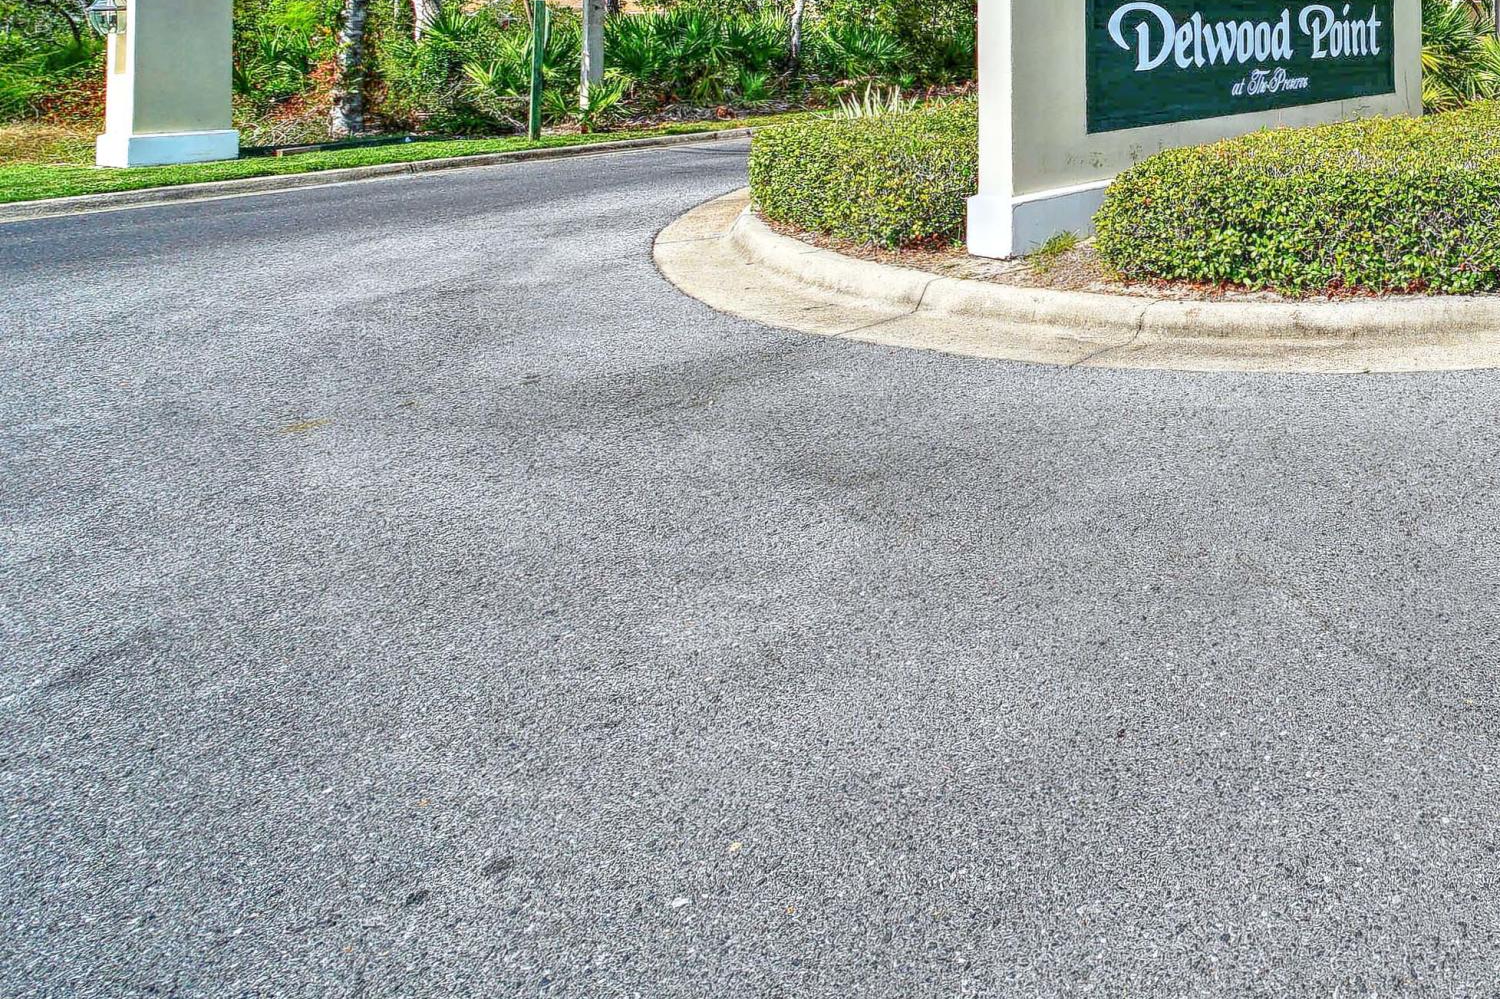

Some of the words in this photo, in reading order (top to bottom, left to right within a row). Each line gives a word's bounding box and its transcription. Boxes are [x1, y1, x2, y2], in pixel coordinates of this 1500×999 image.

[1107, 1, 1293, 72] Delwood
[1298, 3, 1381, 59] Point
[1231, 77, 1245, 96] at
[1247, 68, 1269, 95] The
